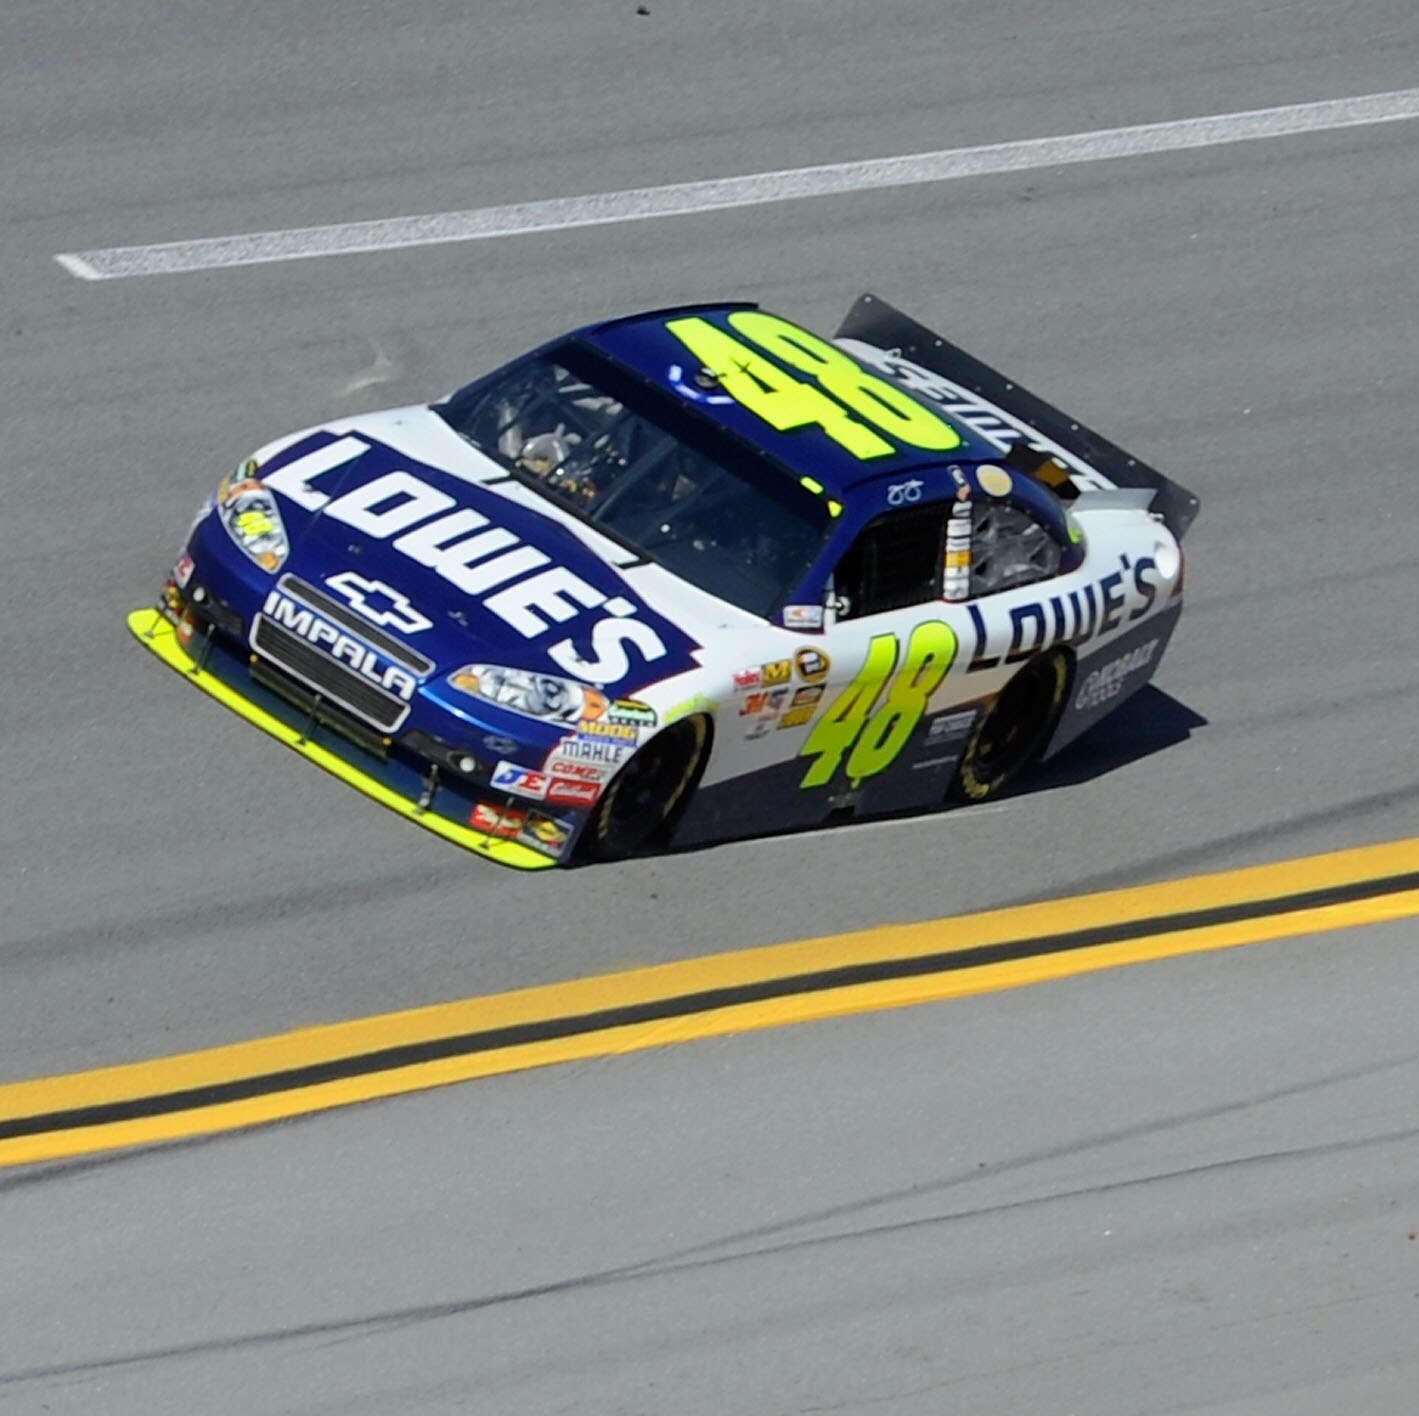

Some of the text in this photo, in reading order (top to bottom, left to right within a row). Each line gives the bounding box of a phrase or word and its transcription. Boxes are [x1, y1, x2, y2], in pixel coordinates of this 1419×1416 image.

[665, 311, 961, 460] 48
[262, 435, 667, 685] LOWE'S
[966, 553, 1157, 673] LOWE'S
[264, 590, 415, 702] IMPALA
[800, 620, 960, 789] 48
[494, 768, 547, 792] JE
[563, 741, 623, 764] MAHLE
